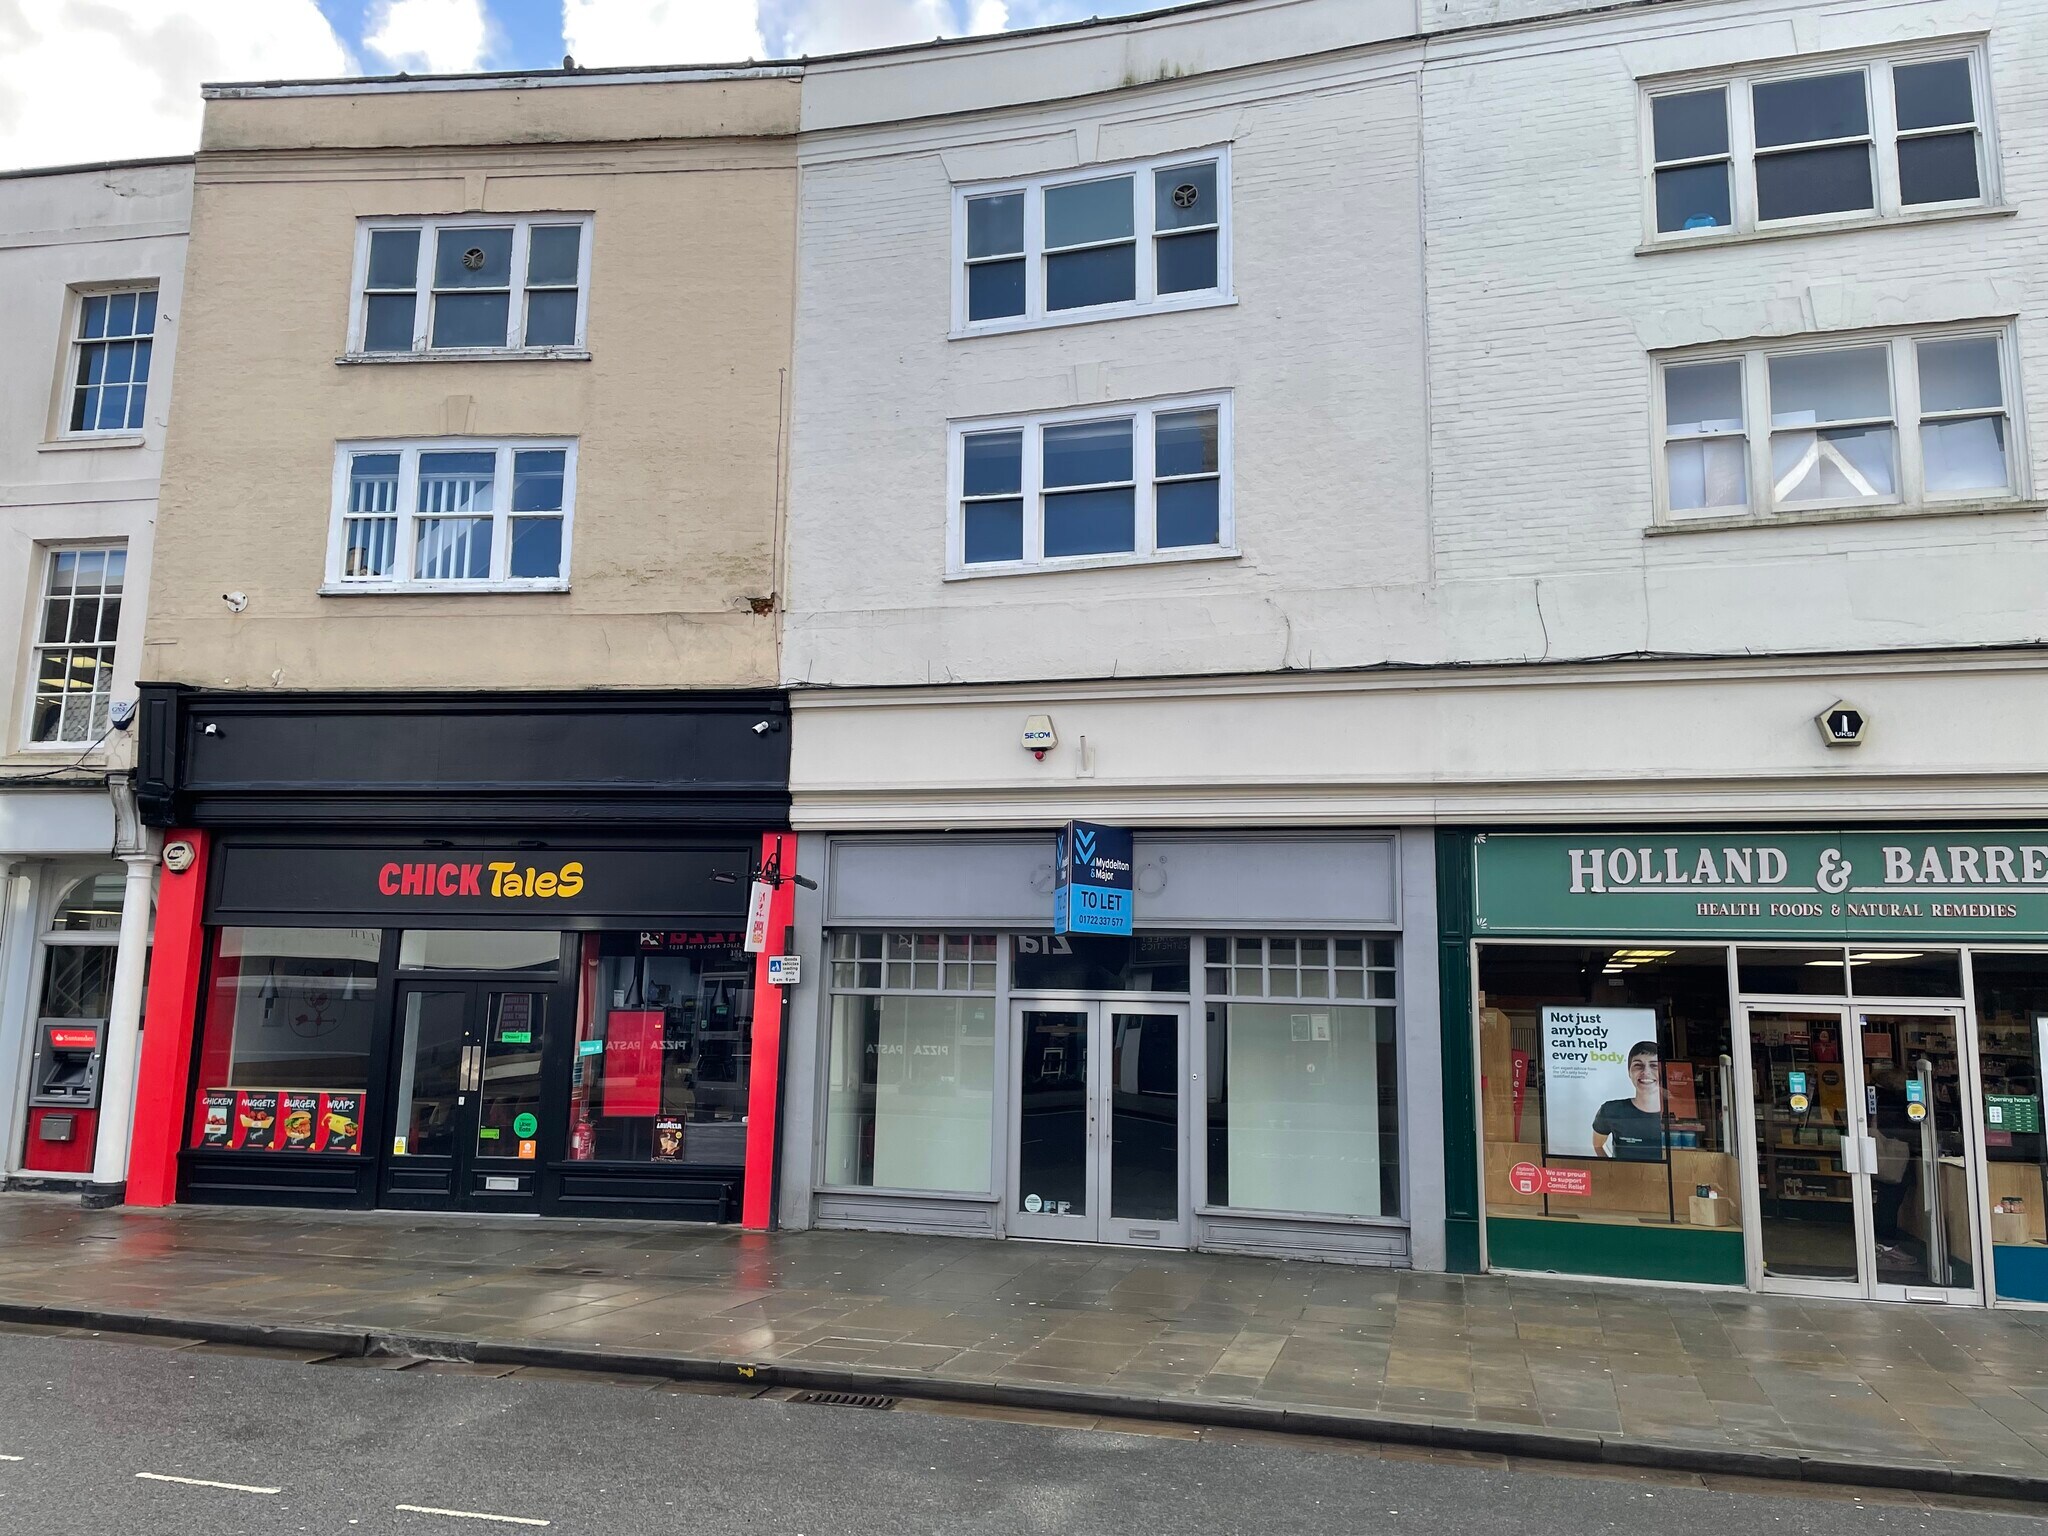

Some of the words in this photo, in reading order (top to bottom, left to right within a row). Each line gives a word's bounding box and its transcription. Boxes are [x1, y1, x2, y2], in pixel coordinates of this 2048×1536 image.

[1095, 857, 1130, 871] Myddelton
[1568, 848, 1788, 893] HOLLAND
[1816, 848, 1852, 894] &
[378, 862, 483, 896] CHICK
[1081, 891, 1098, 908] TO
[1100, 893, 1123, 911] LET
[1696, 904, 1760, 916] HEALTH
[1770, 904, 1822, 917] FOODS
[1830, 904, 1841, 916] &
[1847, 904, 1923, 917] NATURAL
[1932, 904, 2017, 918] REMEDIES
[1079, 915, 1098, 925] 01722
[1099, 917, 1111, 926] 337
[1112, 917, 1123, 927] 577
[1550, 1012, 1573, 1023] Not
[1576, 1013, 1601, 1026] just
[64, 1034, 94, 1042] Santander
[1551, 1025, 1609, 1039] anybody
[1551, 1040, 1576, 1048] can
[1578, 1038, 1608, 1051] help
[1552, 1052, 1588, 1063] every
[1590, 1051, 1627, 1064] body.
[202, 1097, 233, 1106] CHICKEN
[241, 1099, 276, 1108] NUGGETS
[284, 1099, 316, 1110] BURGER
[326, 1099, 355, 1110] WRAPS
